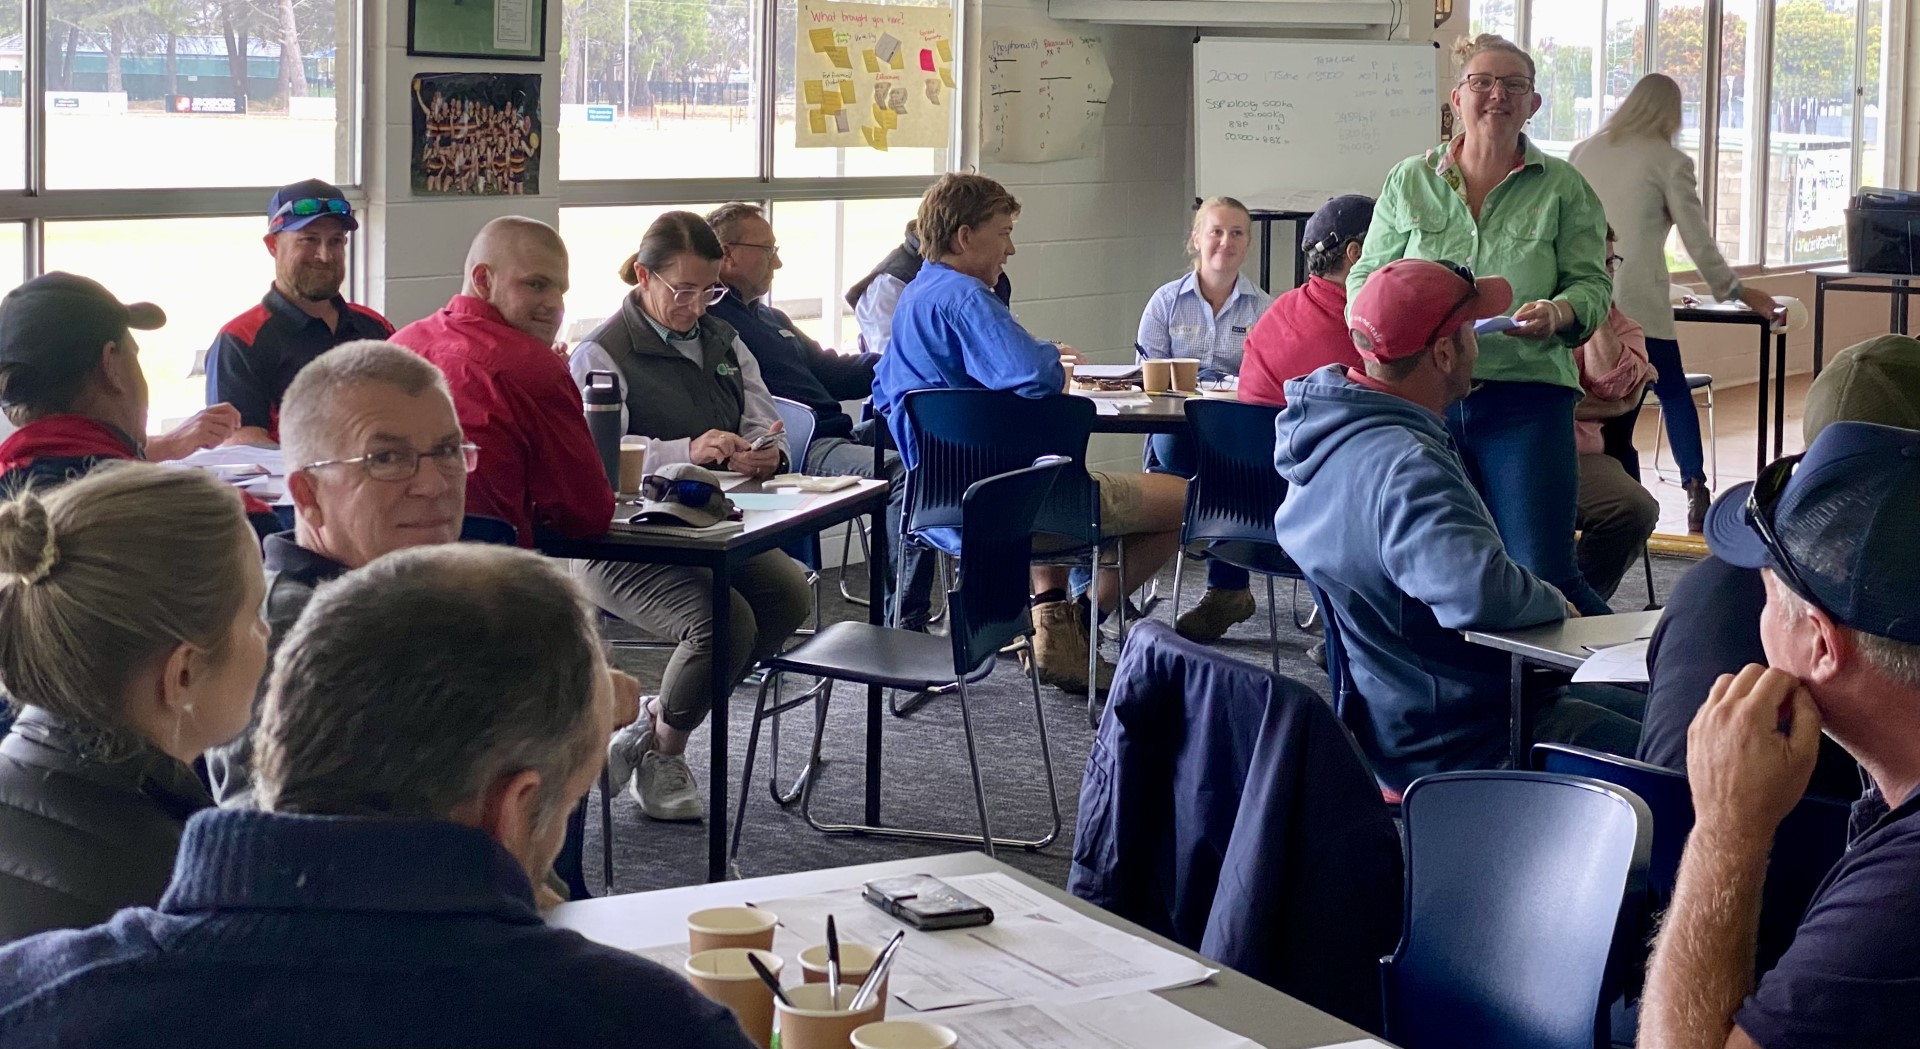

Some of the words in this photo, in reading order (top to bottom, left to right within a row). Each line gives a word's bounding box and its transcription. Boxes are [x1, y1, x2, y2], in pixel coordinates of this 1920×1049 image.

[811, 10, 836, 23] What
[841, 10, 868, 28] brought
[872, 16, 884, 28] you
[1207, 69, 1249, 84] 2000
